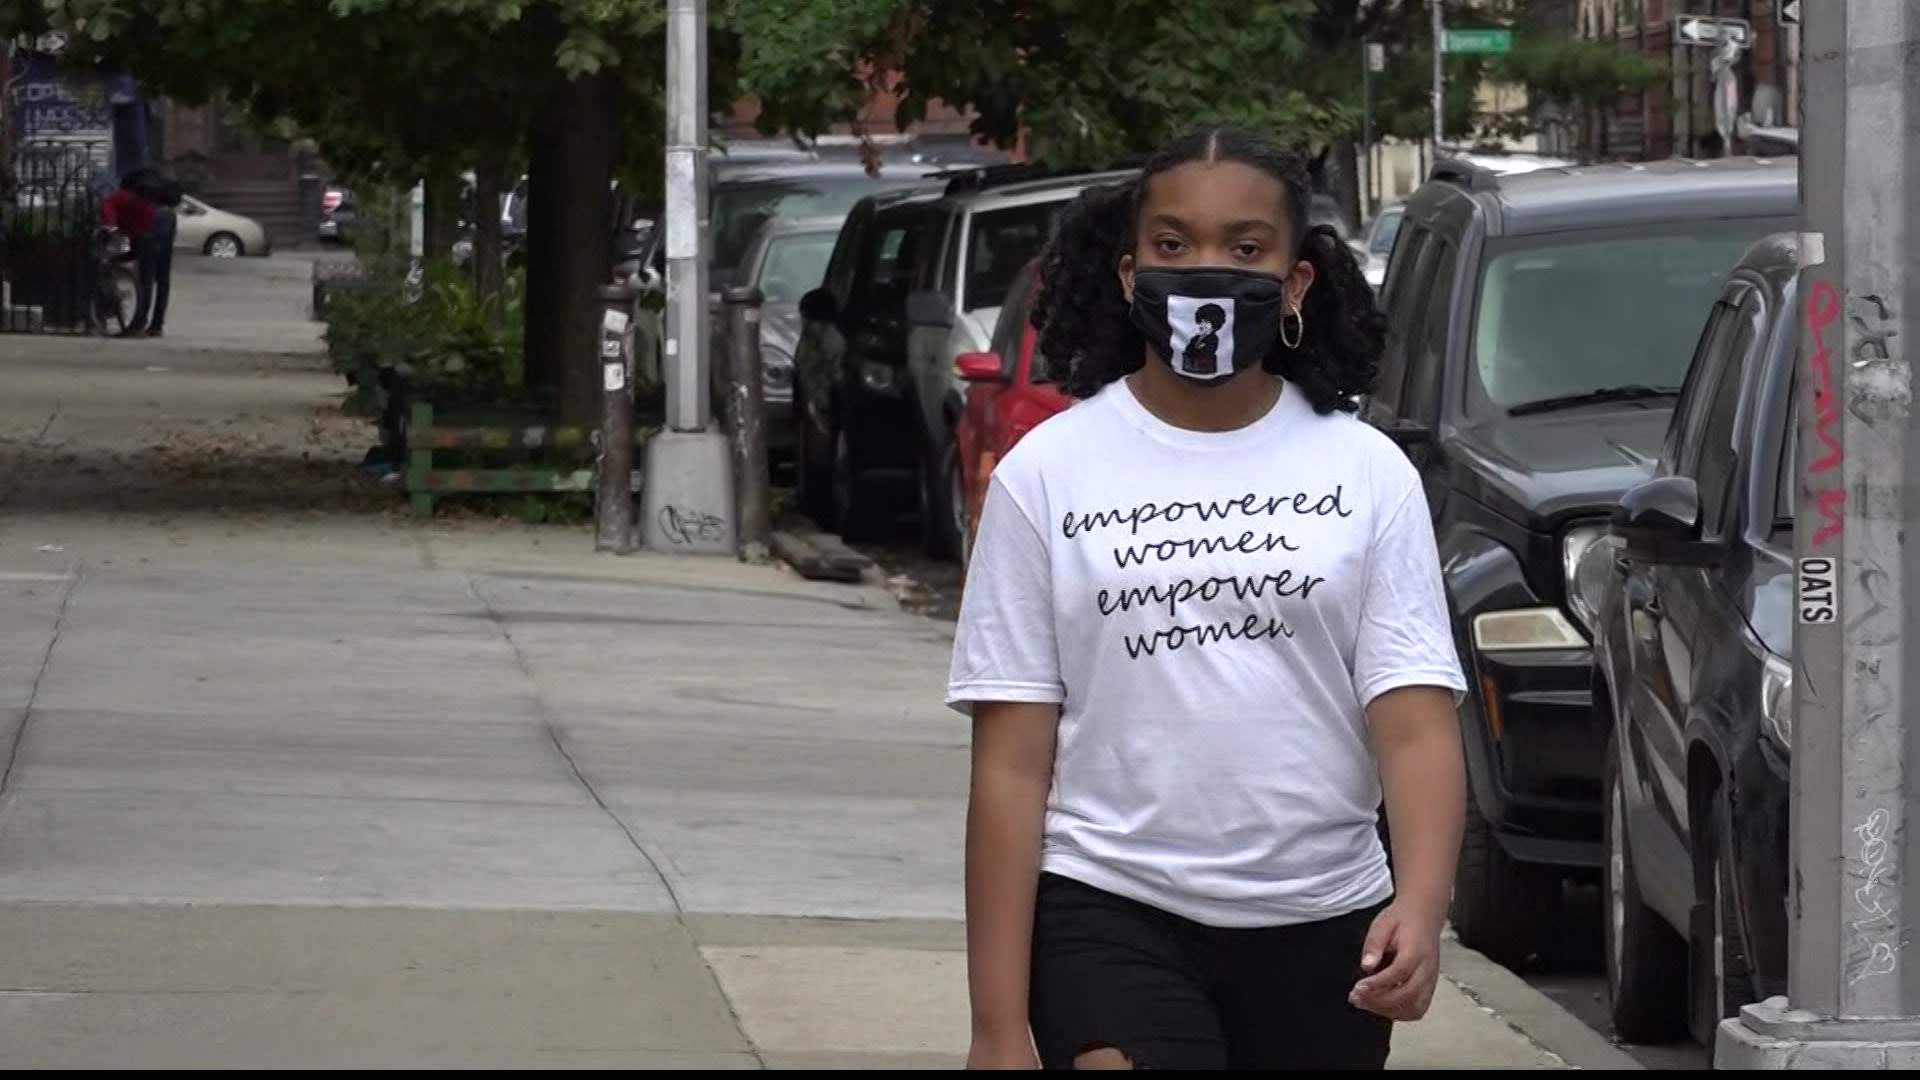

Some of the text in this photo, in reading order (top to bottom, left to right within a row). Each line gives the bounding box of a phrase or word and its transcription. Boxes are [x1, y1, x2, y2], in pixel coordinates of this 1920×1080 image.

[1063, 485, 1352, 538] empowered
[1114, 531, 1300, 568] women
[1098, 570, 1325, 617] empower
[1801, 559, 1833, 622] OATS
[1125, 614, 1294, 659] women
